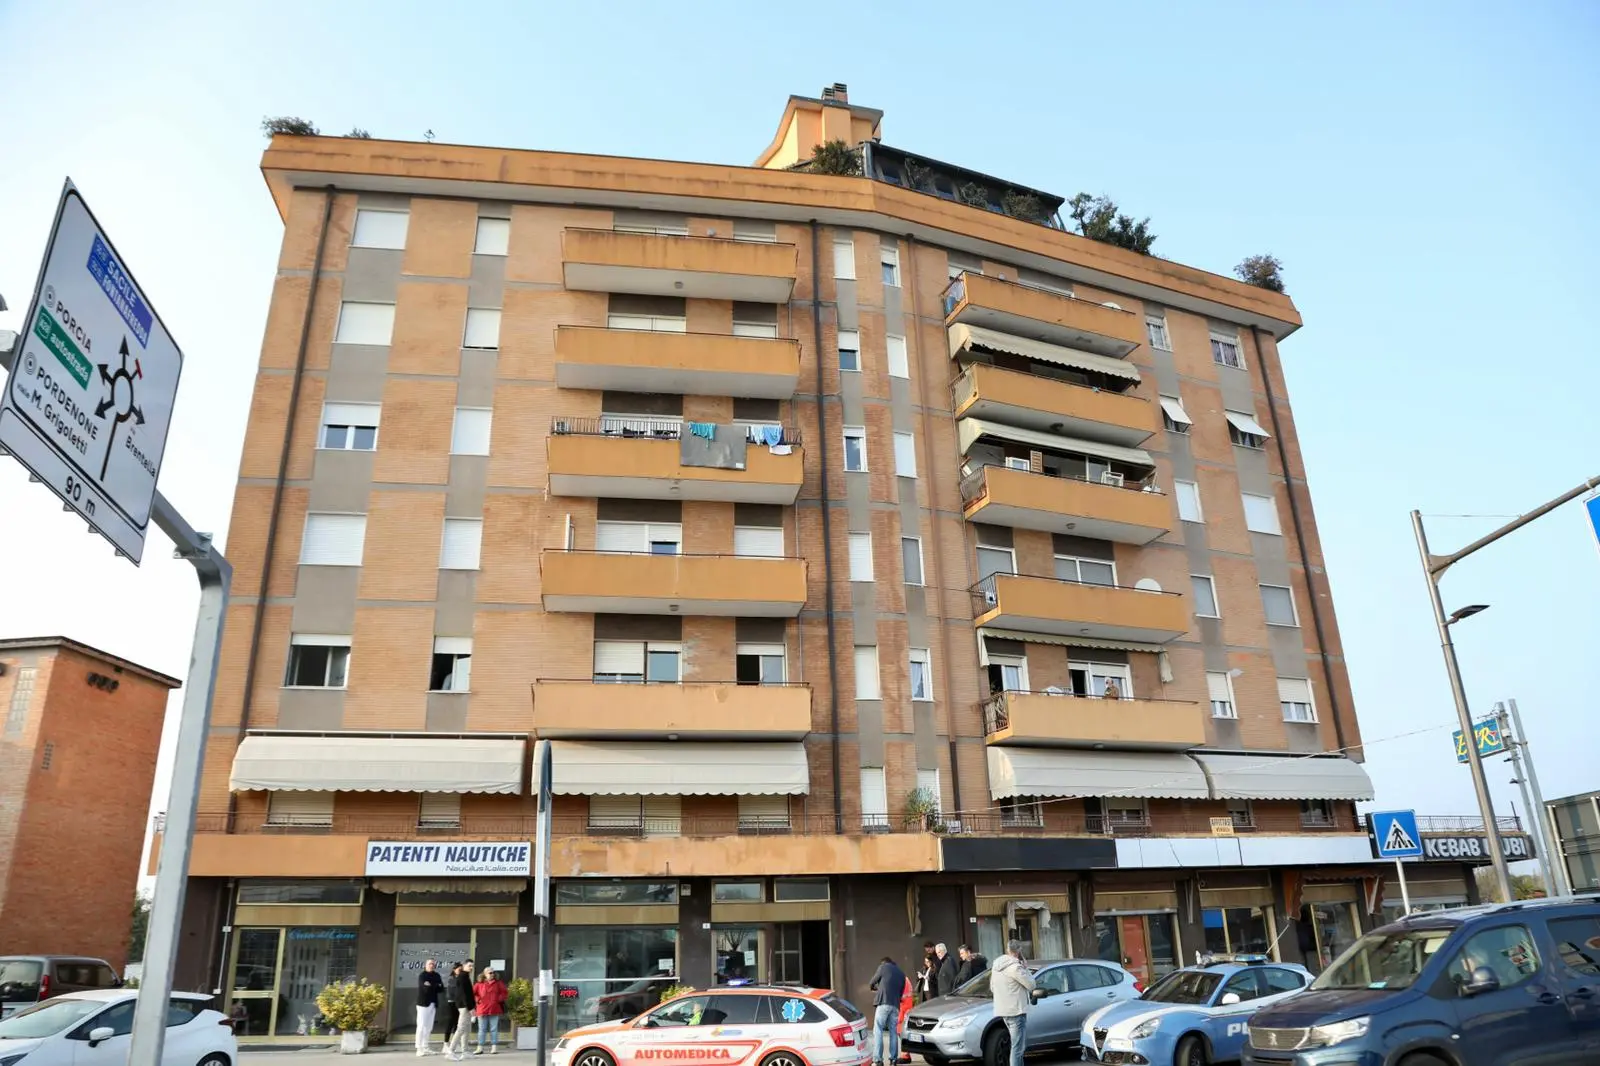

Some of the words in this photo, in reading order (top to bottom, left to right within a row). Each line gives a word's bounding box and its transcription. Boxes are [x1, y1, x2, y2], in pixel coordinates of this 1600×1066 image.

[107, 260, 137, 308] SACILE
[56, 300, 92, 353] PORCIA
[50, 333, 89, 382] autostrada
[31, 388, 43, 412] M.
[44, 403, 88, 456] Grigoletti
[36, 366, 99, 441] PORDENONE
[125, 435, 156, 477] Brentella
[65, 476, 82, 501] 90
[85, 498, 96, 517] m
[368, 846, 441, 862] PATENTI
[444, 846, 528, 862] NAUTICHE
[1424, 838, 1481, 857] KEBAB
[635, 1048, 731, 1060] AUTOMEDICA
